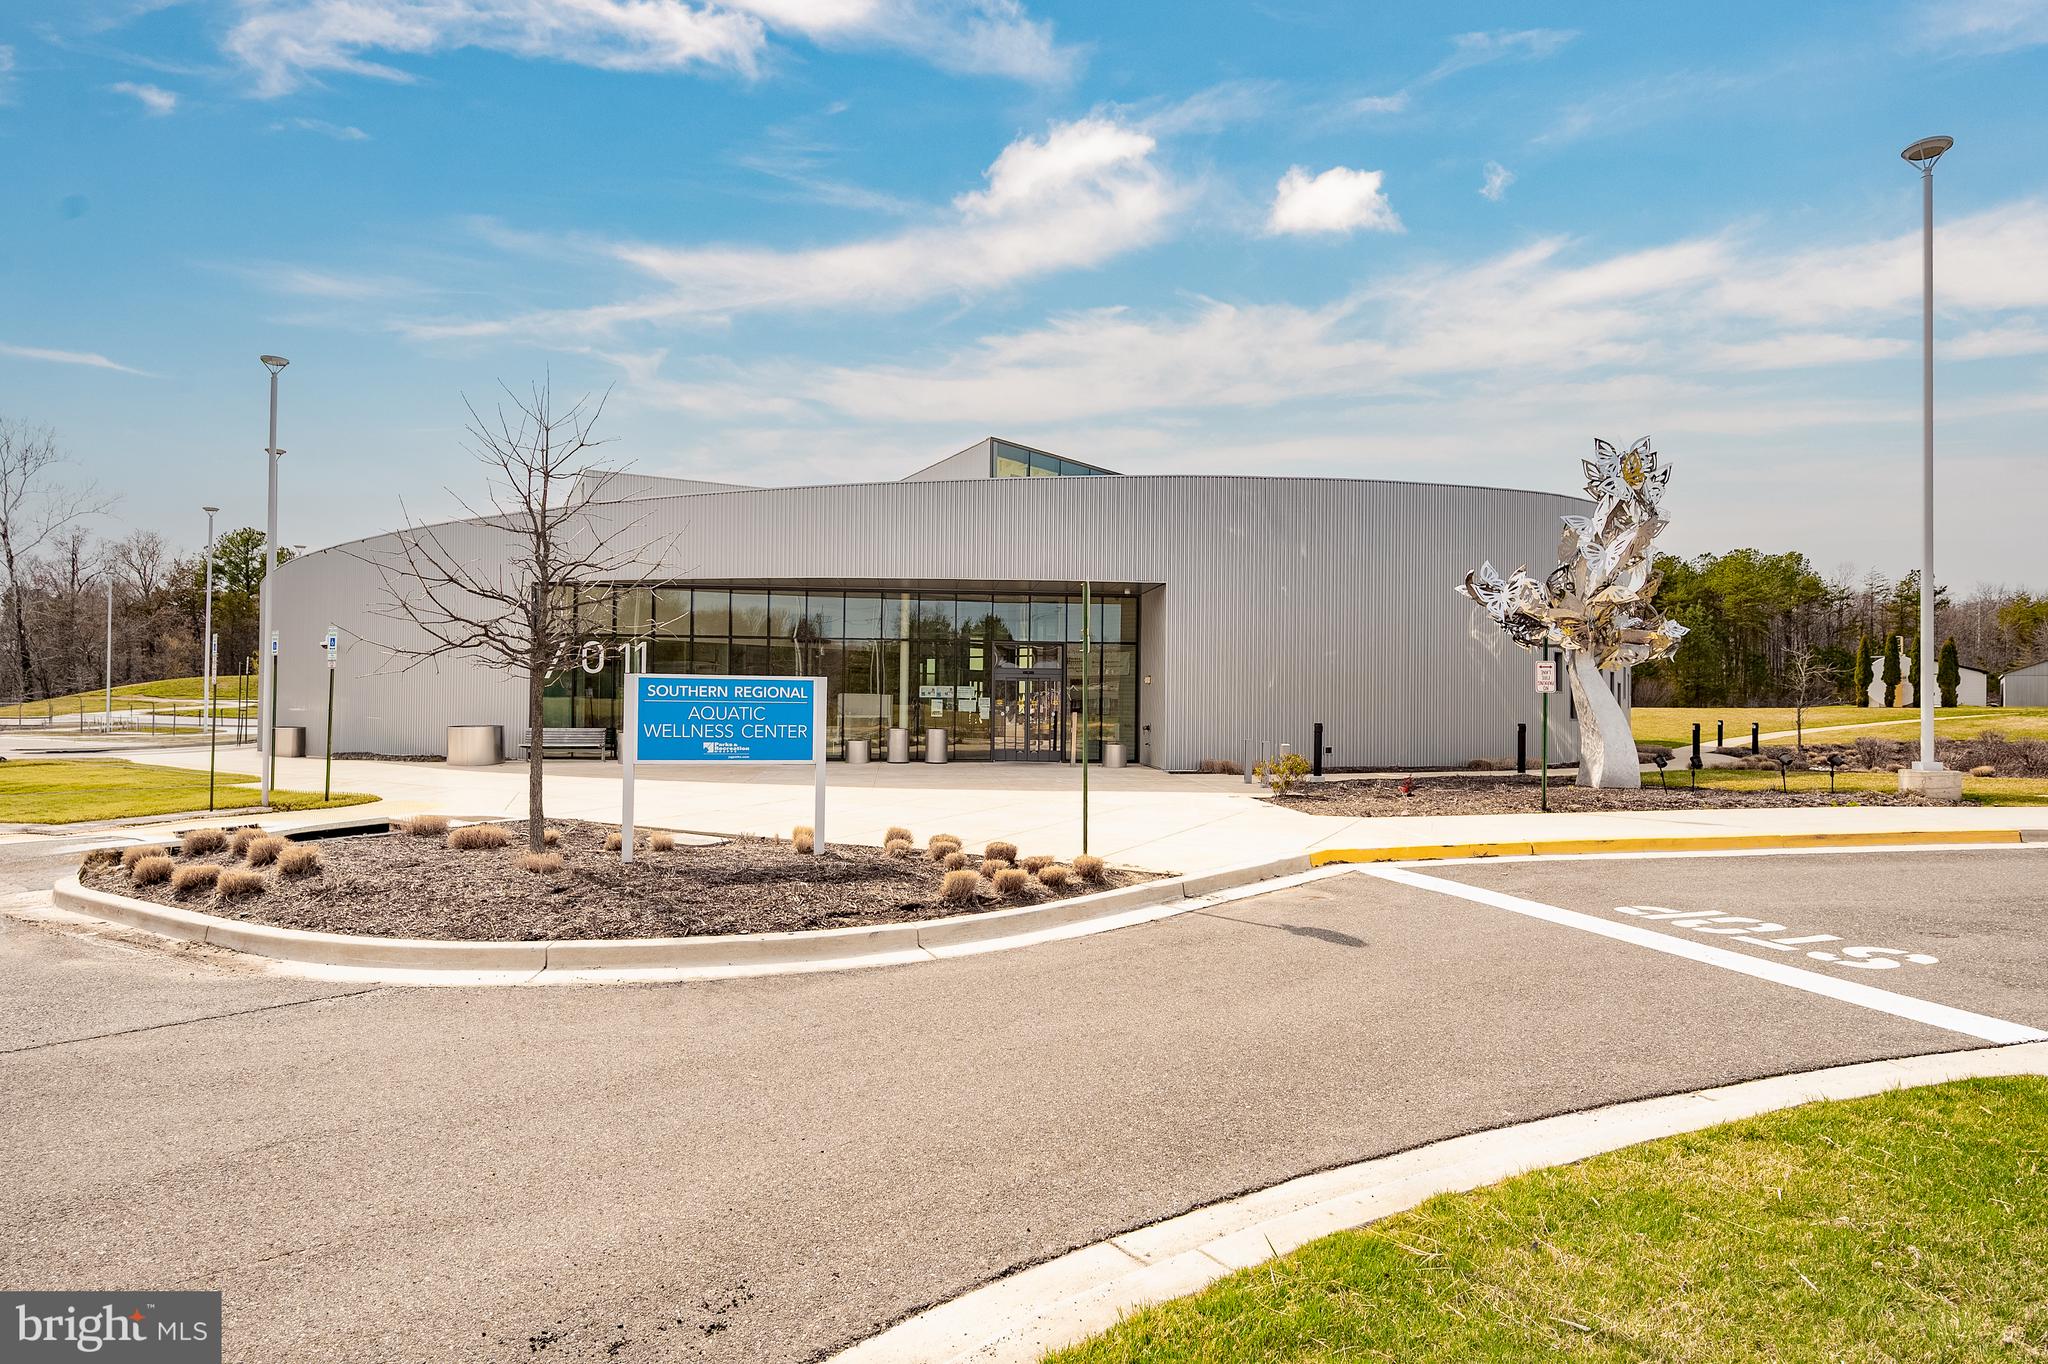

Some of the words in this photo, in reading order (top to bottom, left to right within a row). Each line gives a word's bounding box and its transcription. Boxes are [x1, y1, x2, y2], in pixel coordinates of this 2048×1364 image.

[647, 684, 728, 698] SOUTHERN
[734, 686, 808, 699] REGIONAL
[687, 705, 766, 721] AQUATIC
[643, 723, 734, 739] WELLNESS
[741, 724, 808, 739] CENTER
[1613, 905, 1940, 970] STOP
